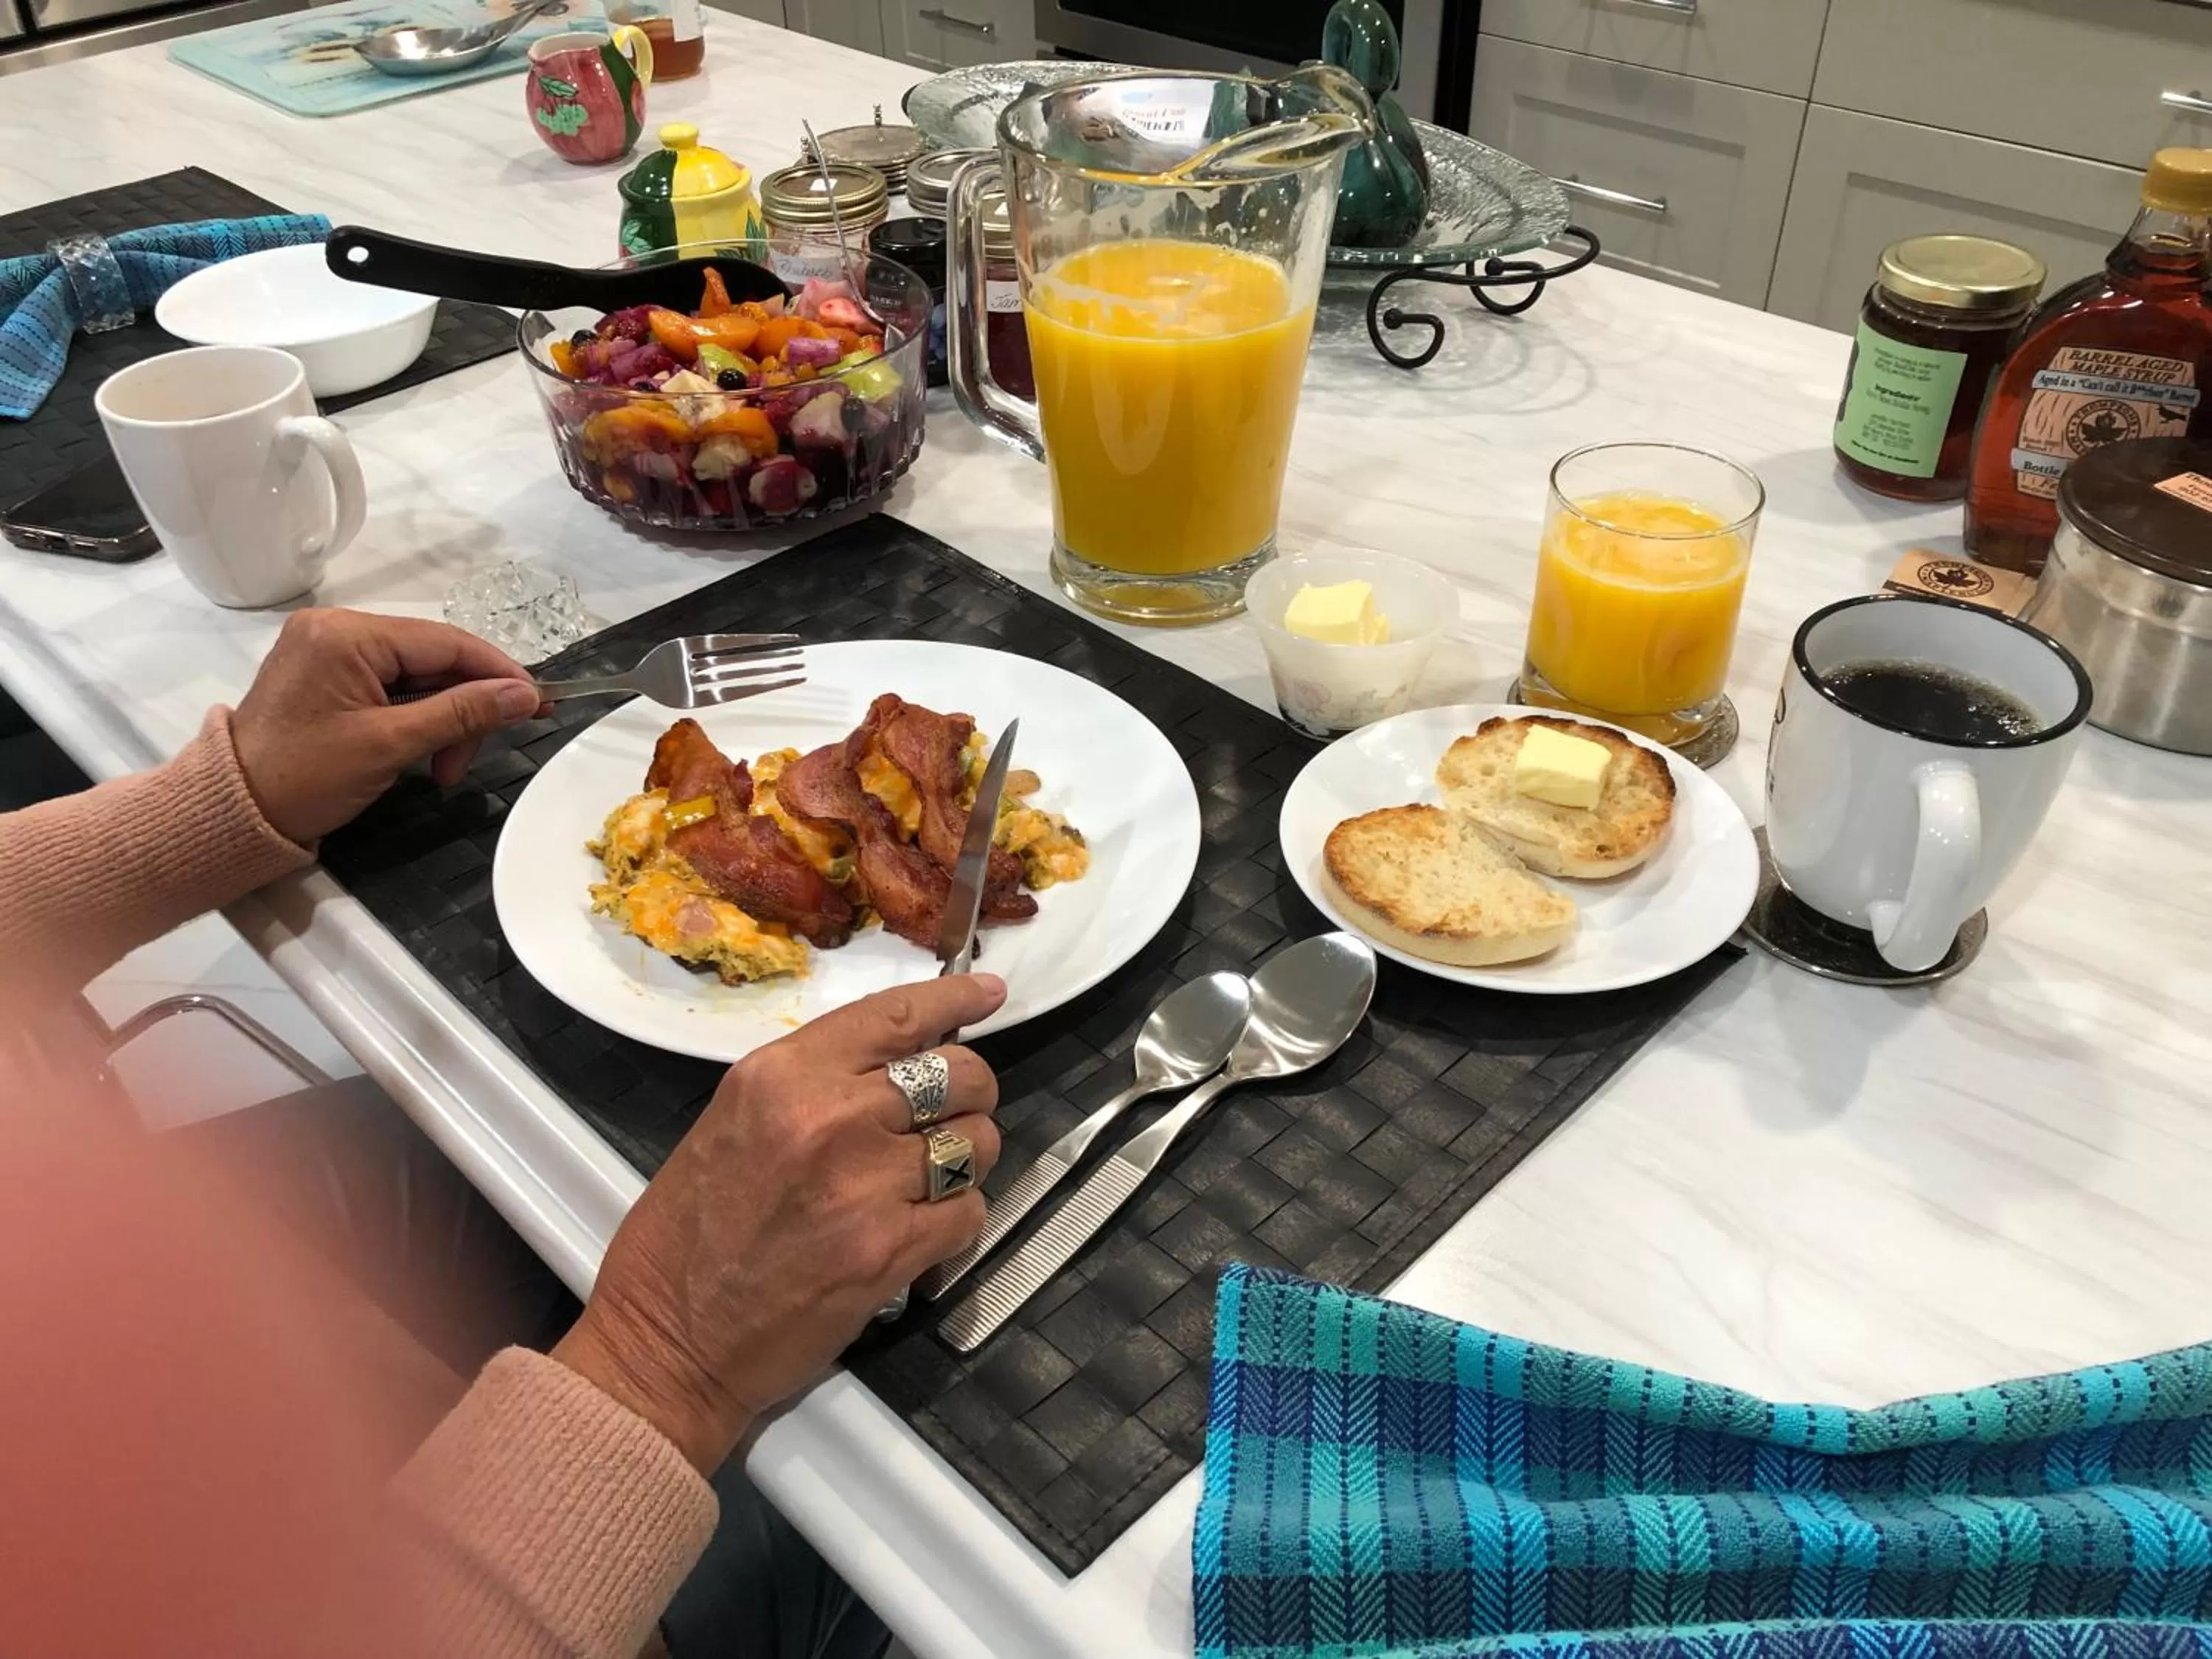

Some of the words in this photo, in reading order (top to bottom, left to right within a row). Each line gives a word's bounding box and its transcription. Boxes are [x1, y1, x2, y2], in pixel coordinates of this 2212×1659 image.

[2069, 349, 2133, 367] BARREL
[2138, 358, 2184, 372] AGED
[2073, 361, 2121, 377] MAPLE
[2124, 367, 2177, 383] SYRUP
[2039, 375, 2059, 387] Aged
[2060, 376, 2070, 386] in
[2105, 381, 2120, 392] call
[2121, 383, 2129, 394] it
[2023, 461, 2060, 476] Bottle
